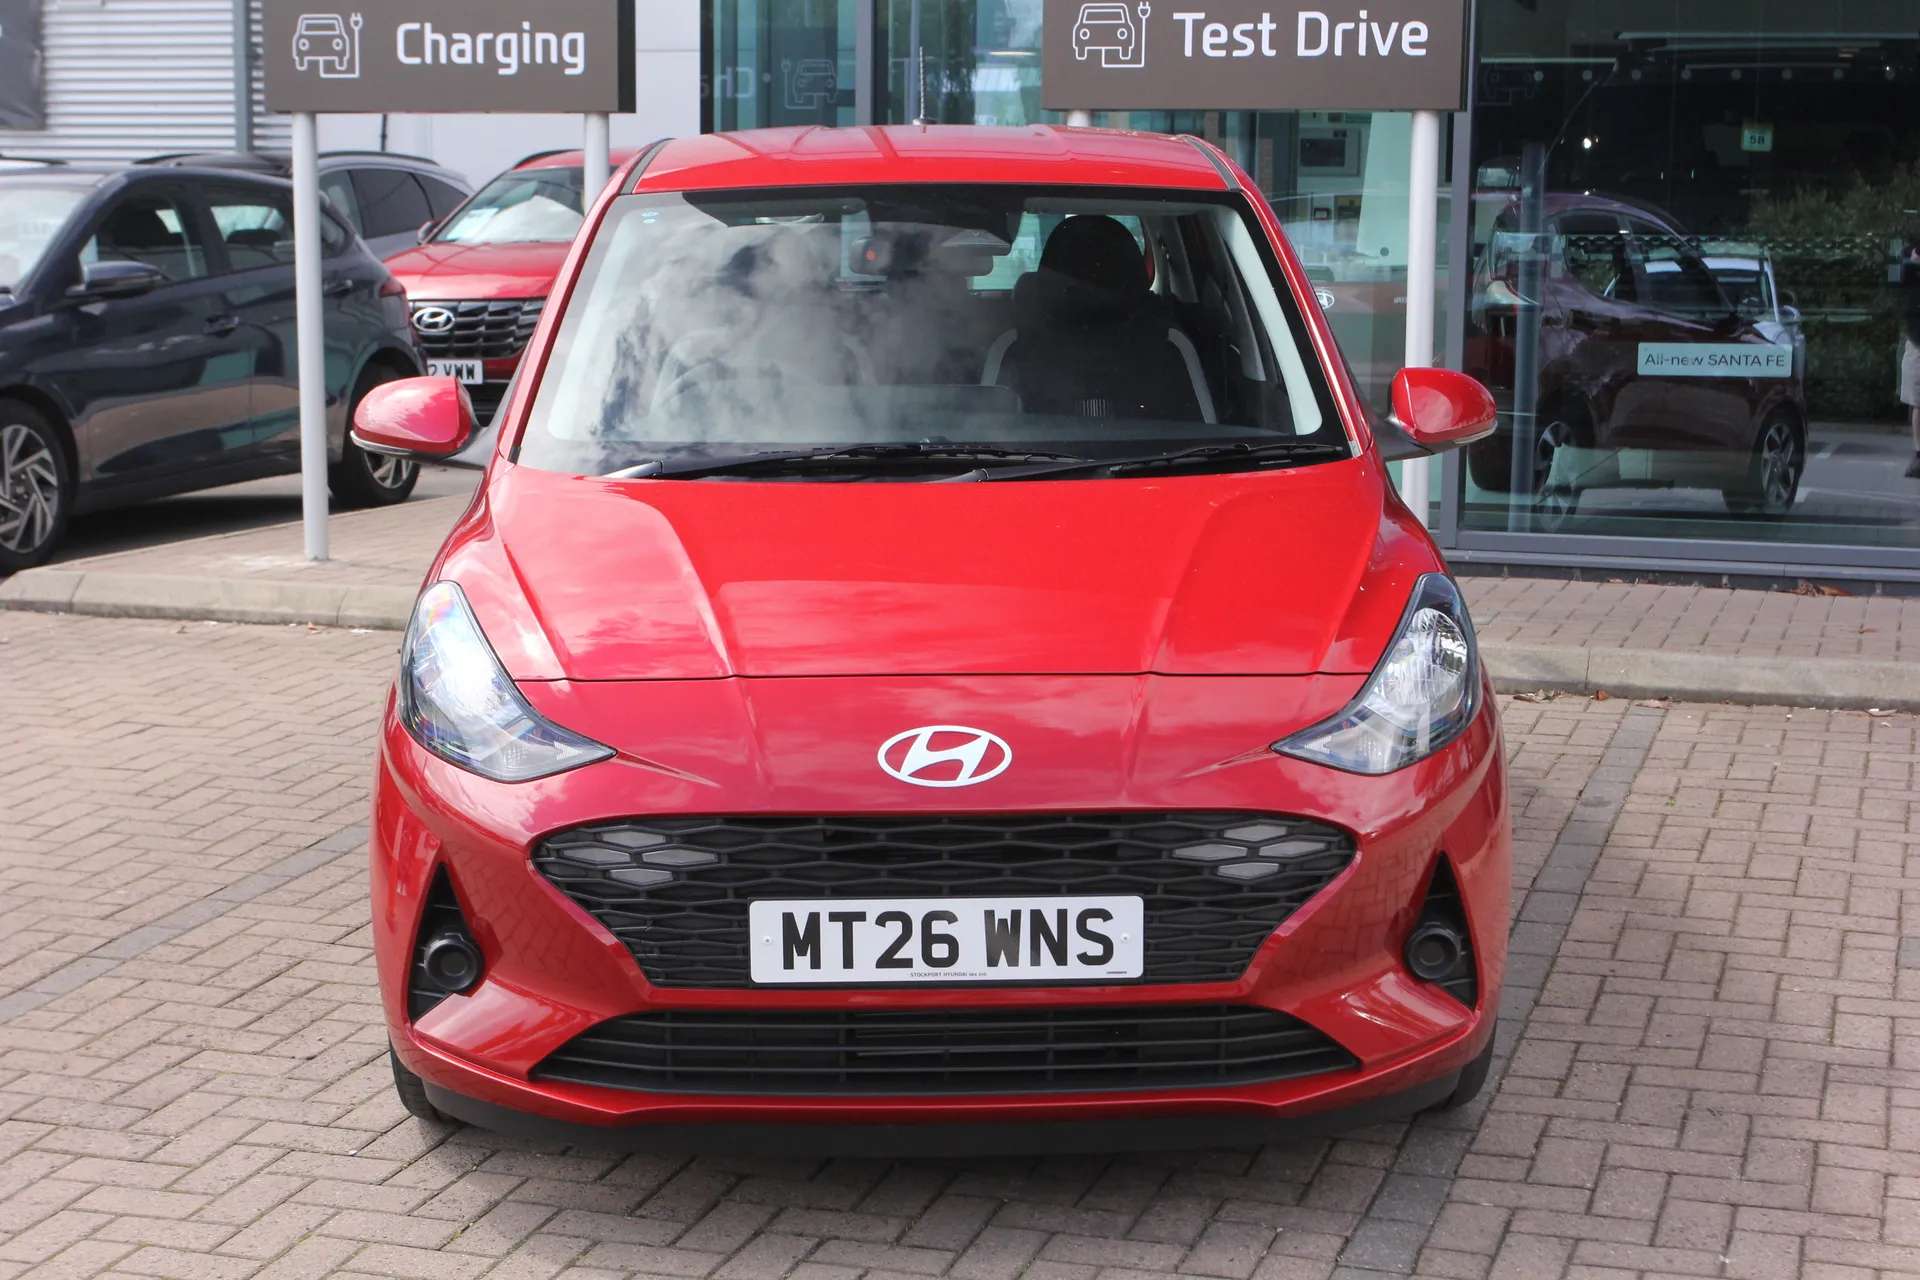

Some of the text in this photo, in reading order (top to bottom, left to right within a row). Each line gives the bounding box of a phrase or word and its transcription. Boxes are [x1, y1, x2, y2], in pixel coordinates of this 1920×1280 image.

[396, 20, 585, 76] Charging
[1173, 9, 1429, 58] Test Drive
[1645, 353, 1785, 367] All-new SANTA FE
[782, 908, 1114, 970] MT26 WNS
